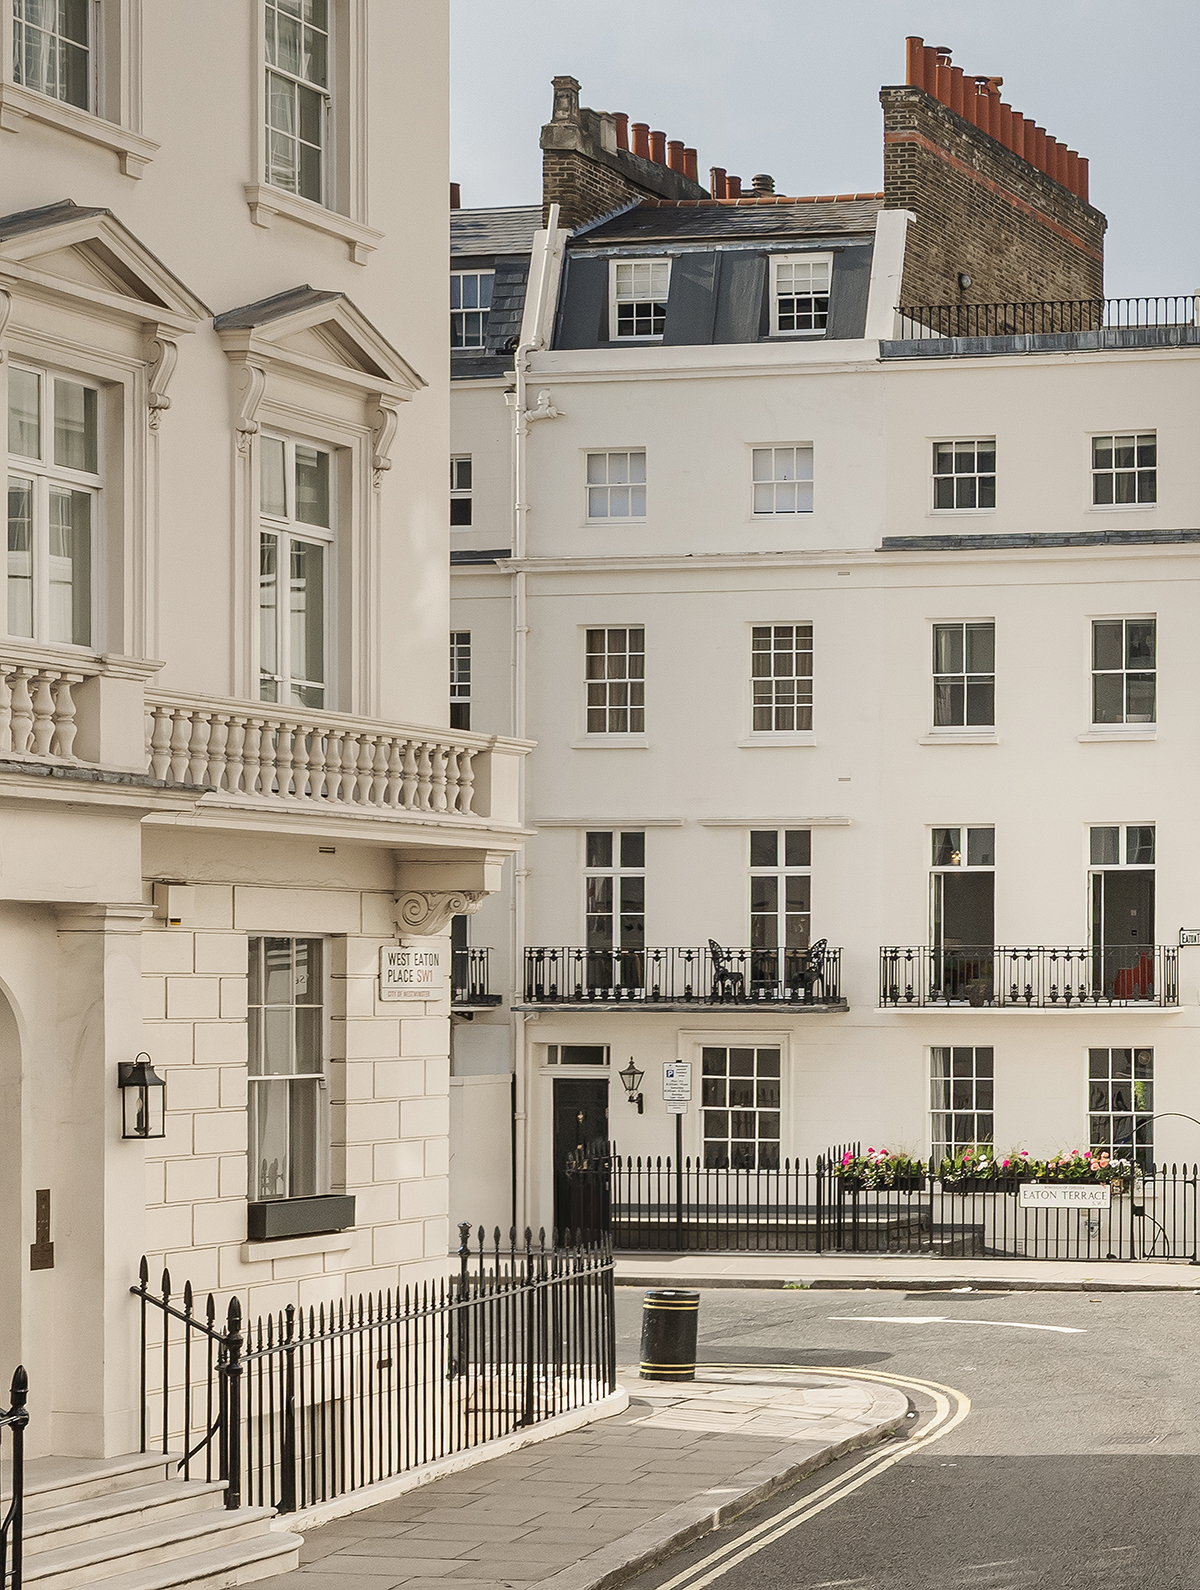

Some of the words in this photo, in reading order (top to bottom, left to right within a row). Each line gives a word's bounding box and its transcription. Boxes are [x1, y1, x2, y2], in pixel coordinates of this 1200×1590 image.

[387, 952, 411, 966] WEST
[414, 952, 440, 966] EATON
[387, 969, 413, 982] PLACE
[416, 969, 433, 983] SW1
[1023, 1190, 1057, 1200] EATON
[1062, 1190, 1107, 1200] TERRACE
